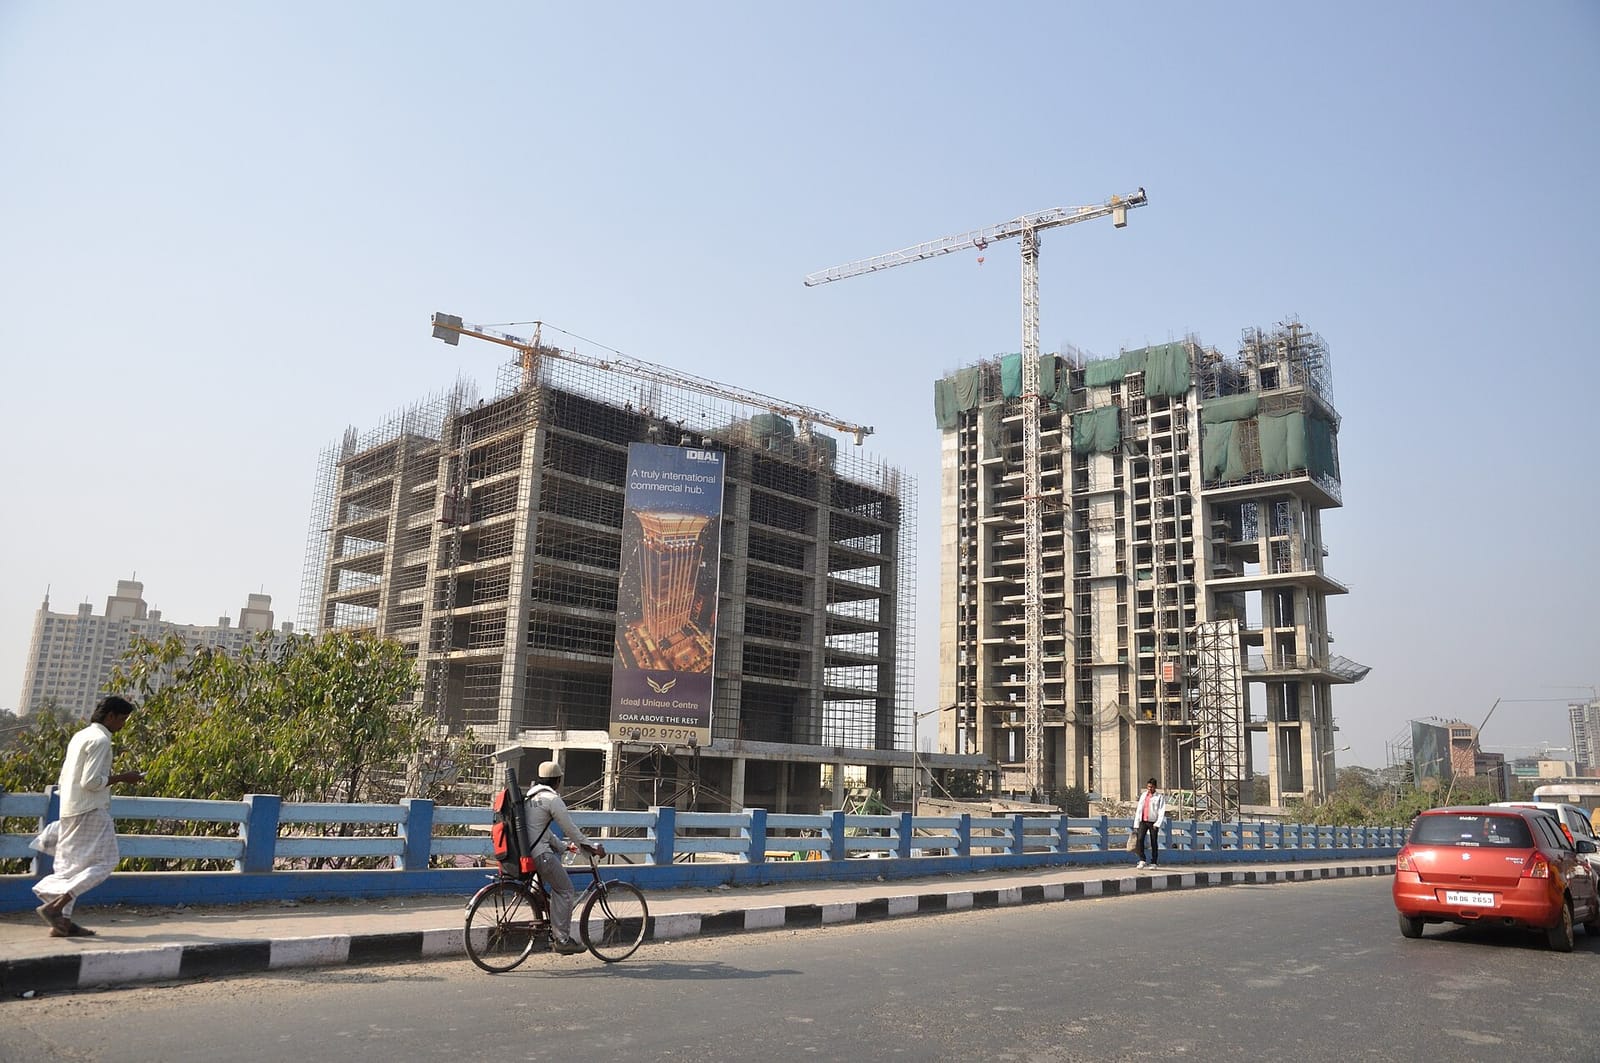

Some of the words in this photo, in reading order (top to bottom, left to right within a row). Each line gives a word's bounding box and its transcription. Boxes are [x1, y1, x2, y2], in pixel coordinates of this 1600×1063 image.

[686, 450, 719, 461] IDEAL
[631, 469, 639, 477] A
[641, 470, 660, 480] truly
[662, 470, 716, 484] international
[630, 482, 682, 493] commercial
[684, 484, 705, 495] hub.
[620, 697, 640, 707] Ideal
[642, 698, 670, 709] Unique
[672, 700, 699, 710] Centre
[619, 713, 639, 721] SOAR
[666, 716, 680, 724] THE
[682, 717, 699, 725] REST
